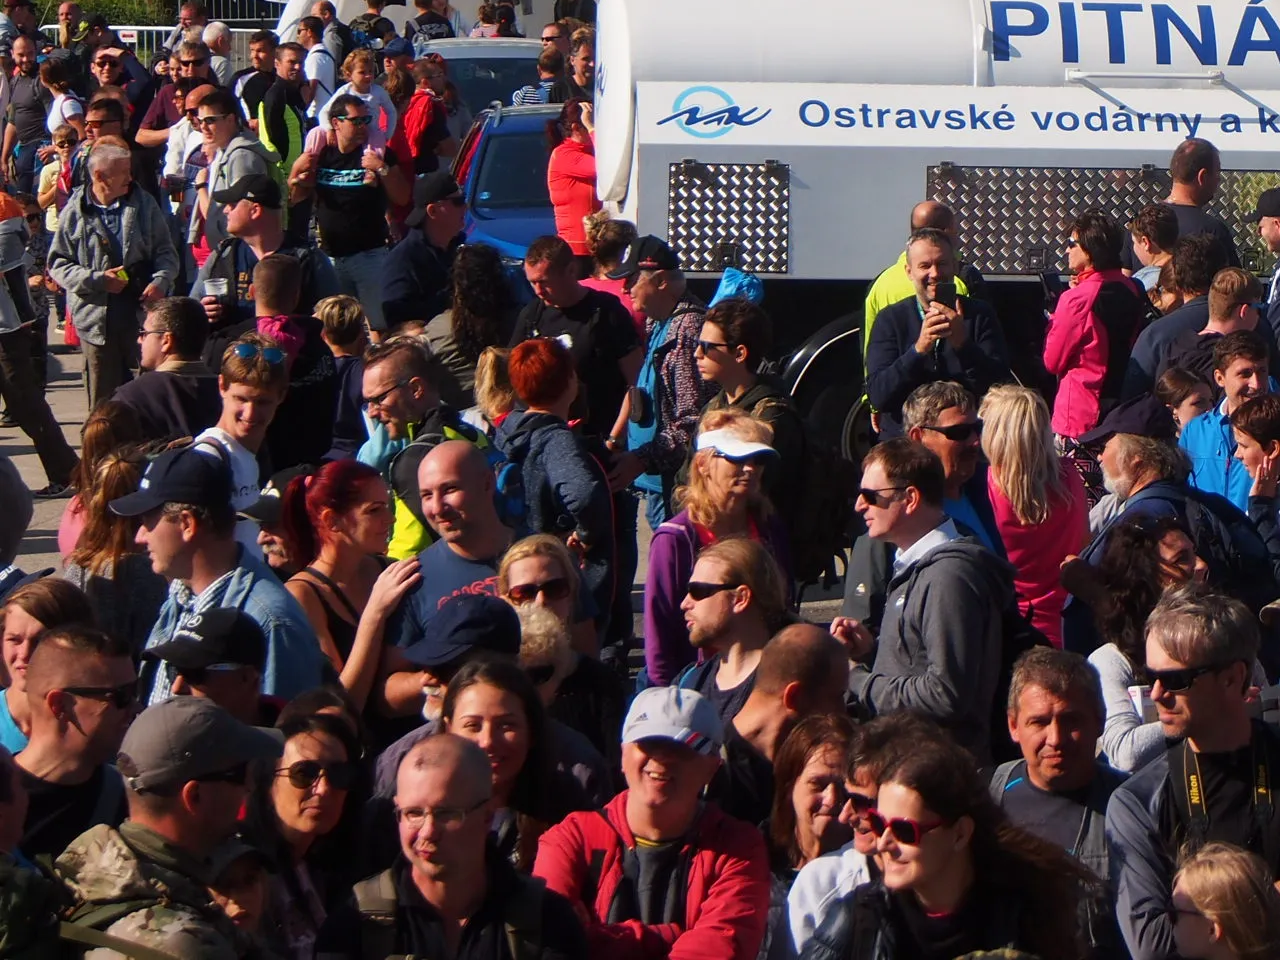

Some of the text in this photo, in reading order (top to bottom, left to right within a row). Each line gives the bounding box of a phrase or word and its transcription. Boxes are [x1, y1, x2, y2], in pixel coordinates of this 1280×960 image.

[798, 99, 1015, 131] Ostravské
[1031, 104, 1201, 139] vodárny
[1219, 113, 1243, 133] a
[1189, 775, 1200, 804] Nikon
